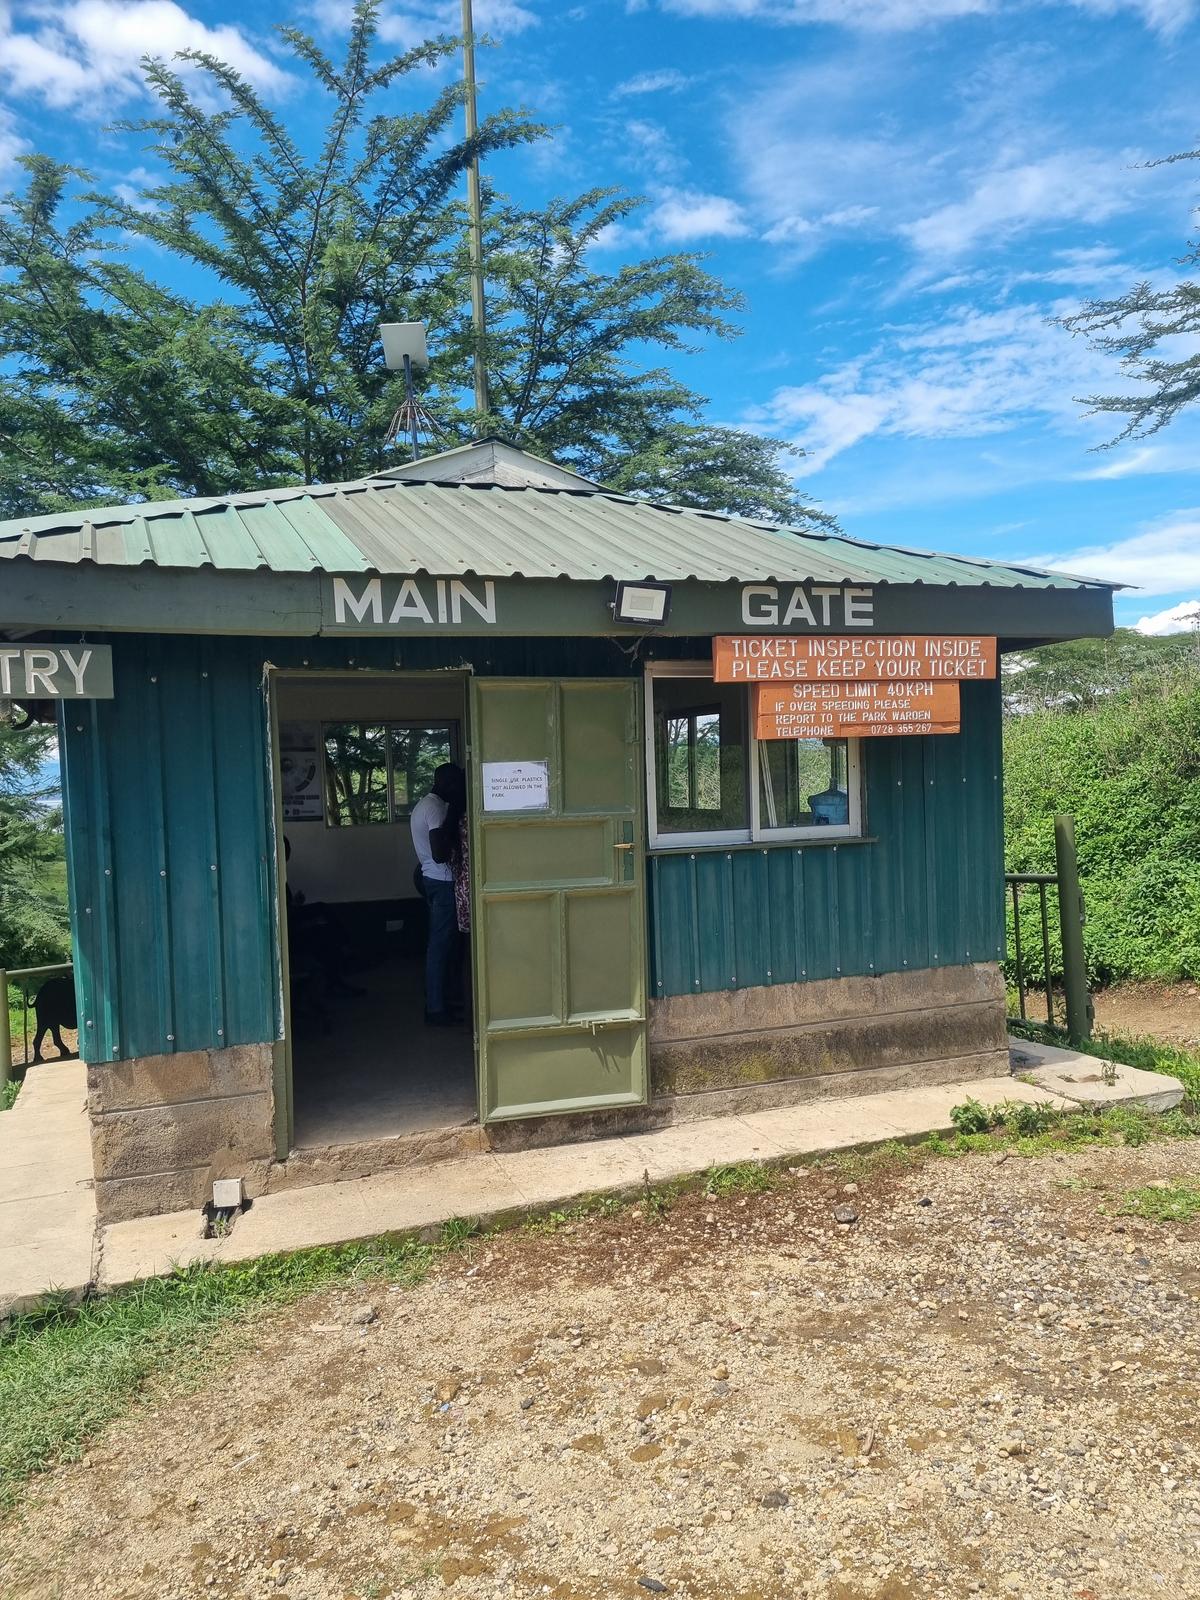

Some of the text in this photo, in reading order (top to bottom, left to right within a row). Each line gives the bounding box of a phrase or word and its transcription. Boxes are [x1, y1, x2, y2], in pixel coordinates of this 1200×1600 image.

[333, 577, 874, 626] MAIN GATE
[732, 639, 981, 657] TICKET INSPECTION INSIDE
[732, 659, 987, 678] PLEASE KEEP YOUR TICKET
[793, 683, 839, 699] SPEED
[846, 682, 879, 697] LIMIT
[775, 699, 911, 712] IF OVER SPEEDING PLEASE
[776, 709, 931, 725] REPORT TO THE PARK WARDEN
[776, 725, 834, 737] TELEPHONE
[871, 724, 893, 735] 0728
[915, 722, 931, 733] 267
